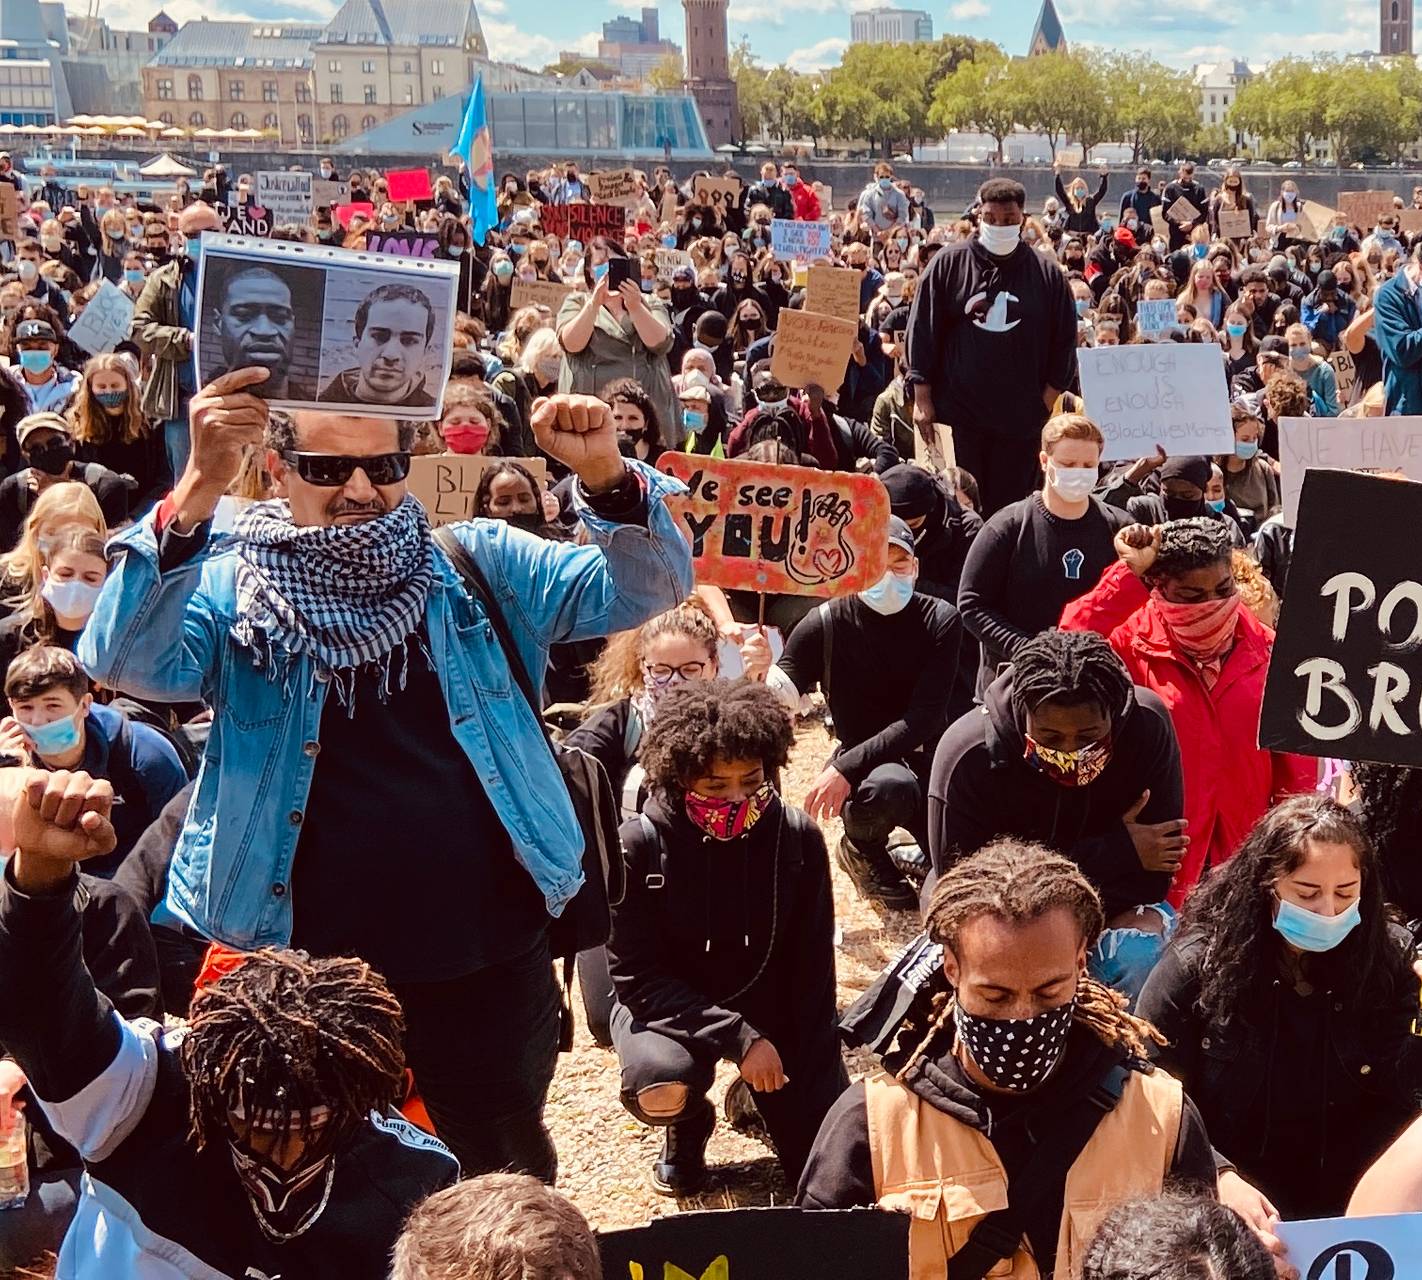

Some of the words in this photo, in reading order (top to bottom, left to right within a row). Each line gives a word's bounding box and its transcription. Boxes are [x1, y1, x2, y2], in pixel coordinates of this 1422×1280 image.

[570, 206, 624, 224] SILENCE
[221, 219, 268, 236] AND
[1095, 351, 1177, 377] ENOUGH
[1336, 355, 1354, 372] BL
[1154, 375, 1176, 396] IS
[1104, 392, 1186, 413] ENOUGH
[1281, 420, 1338, 466] WE
[436, 465, 485, 494] BL
[737, 484, 792, 508] see
